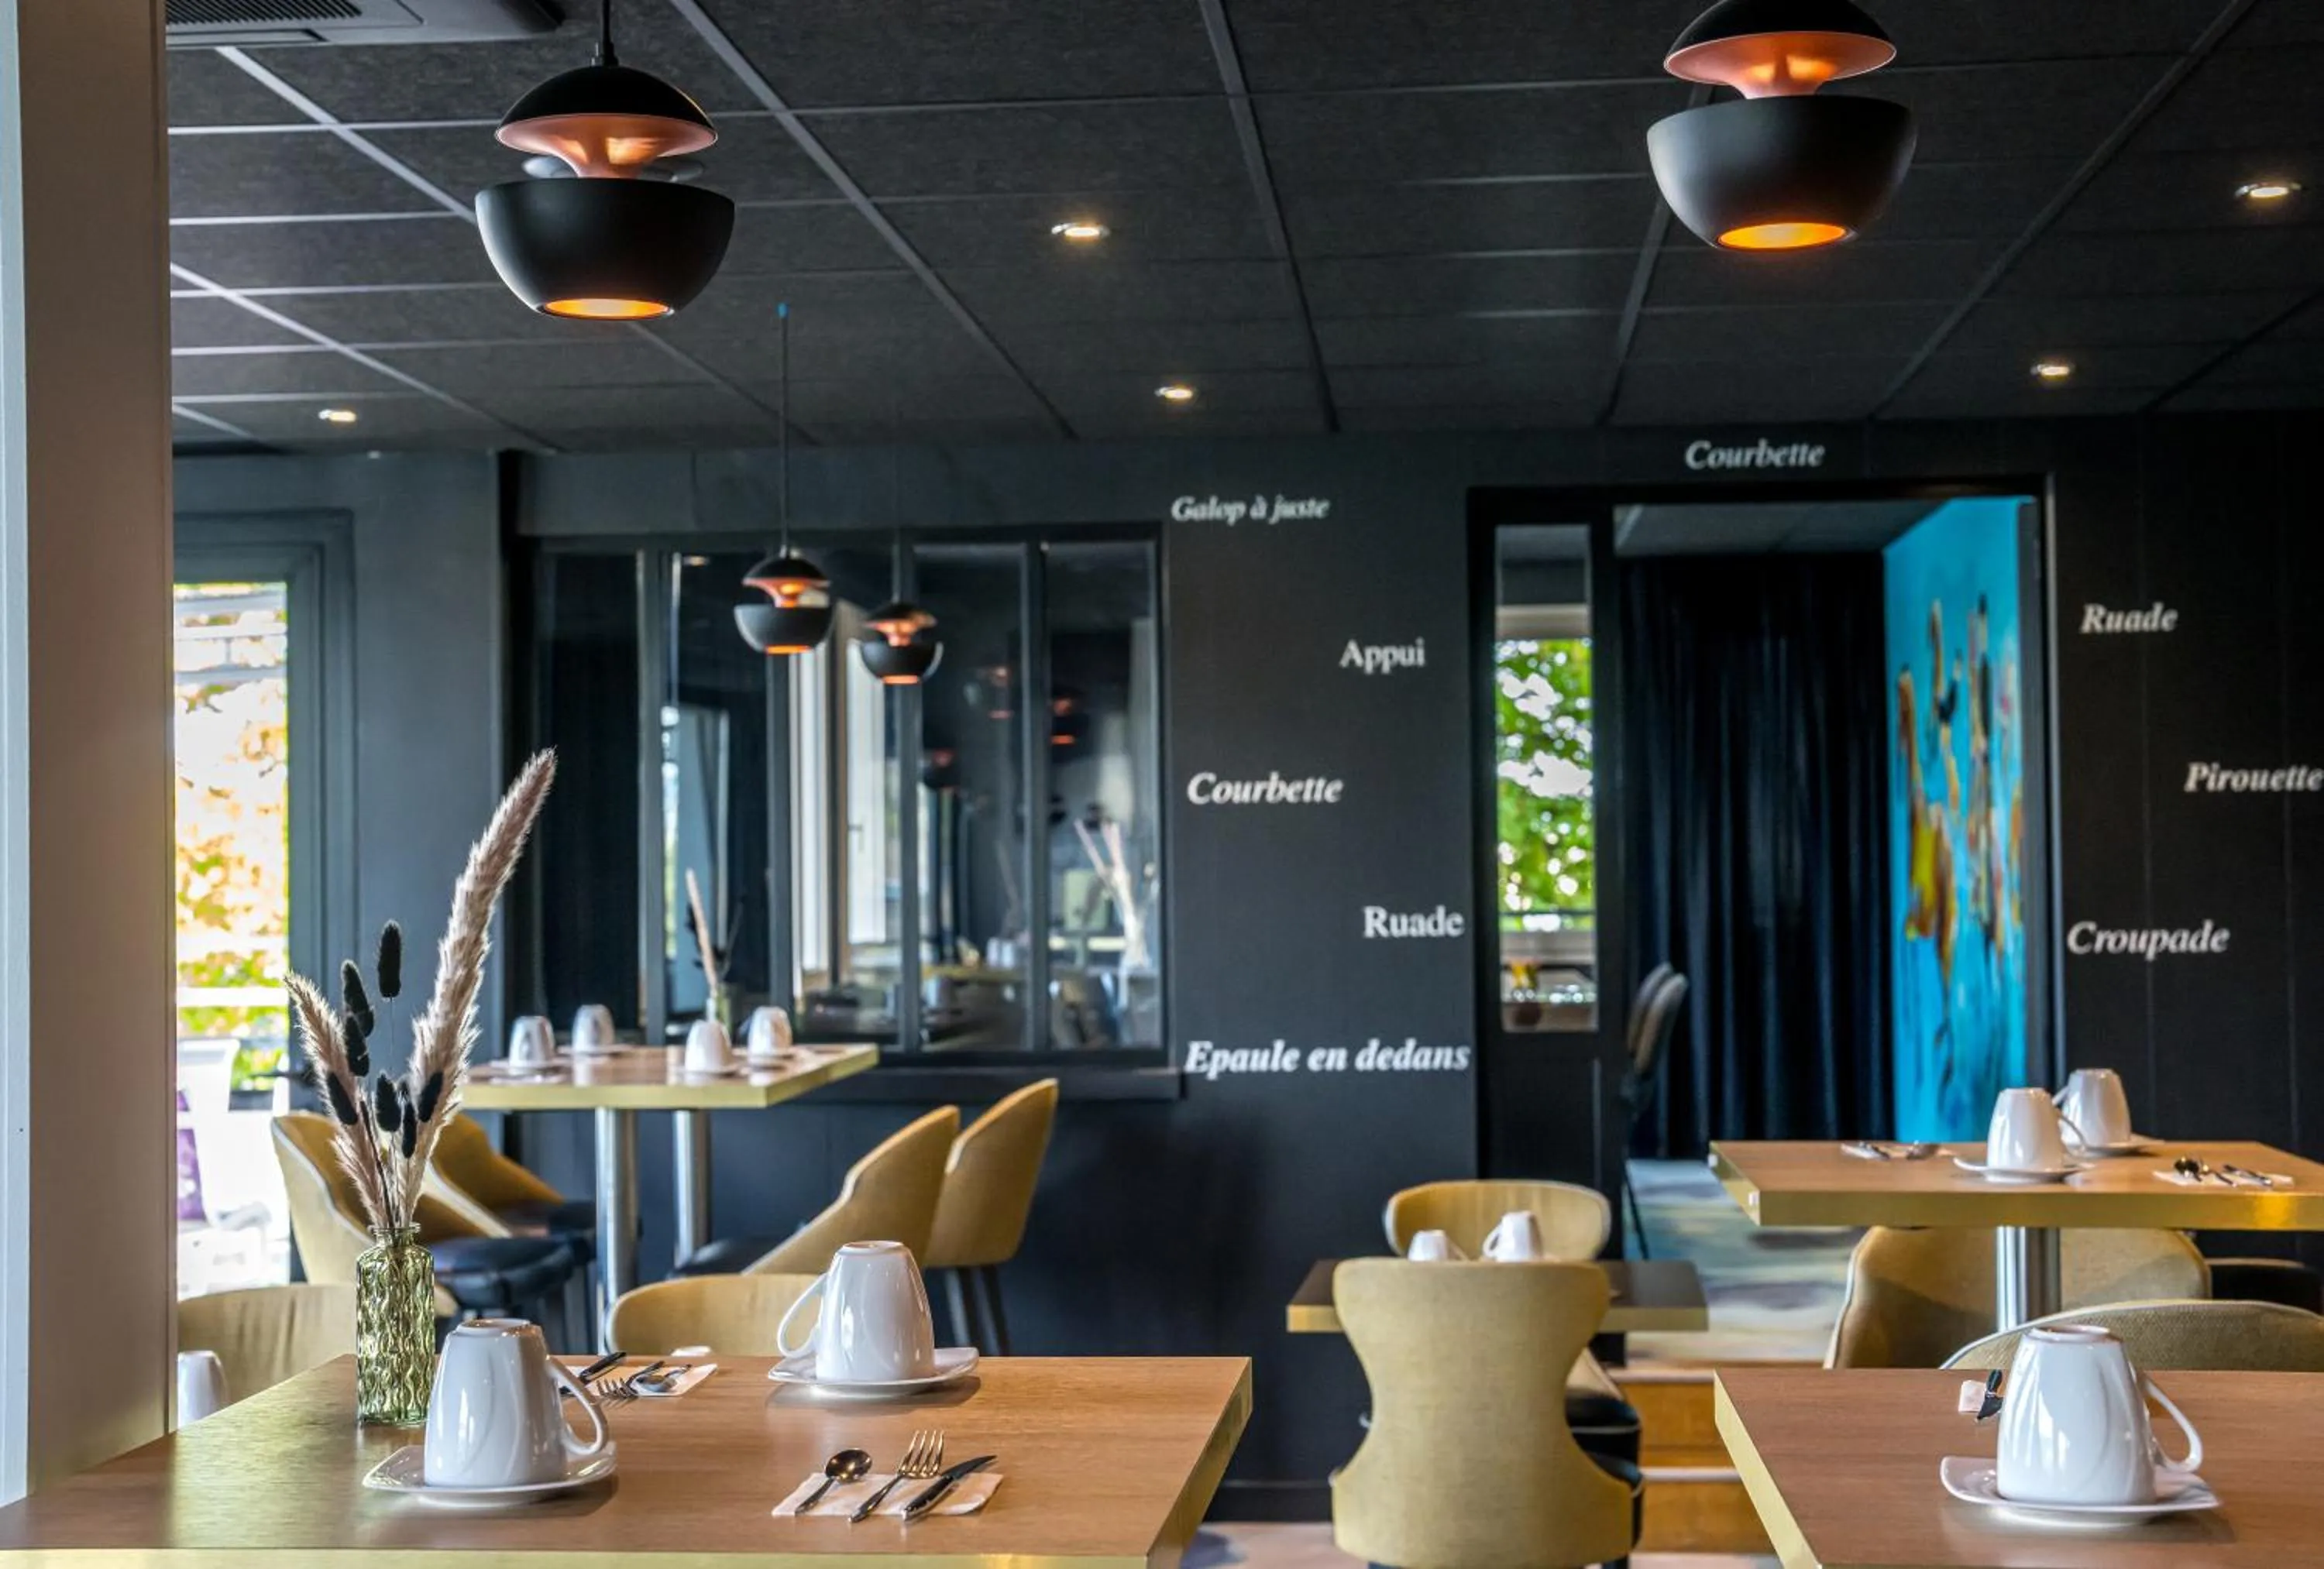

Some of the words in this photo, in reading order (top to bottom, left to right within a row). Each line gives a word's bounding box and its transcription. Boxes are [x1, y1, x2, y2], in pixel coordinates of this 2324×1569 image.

[1683, 438, 1825, 469] Courbette
[1171, 495, 1247, 527] Galop
[1249, 493, 1268, 520] à
[1268, 494, 1330, 526] juste
[2080, 602, 2178, 634] Ruade
[1339, 637, 1425, 675] Appui
[1185, 770, 1345, 806] Courbette
[2184, 761, 2324, 793] Pirouette
[1362, 903, 1465, 939] Ruade
[2066, 918, 2230, 963] Croupade
[1183, 1038, 1302, 1081] Epaule
[1306, 1046, 1349, 1073] en
[1353, 1036, 1472, 1073] dedans
